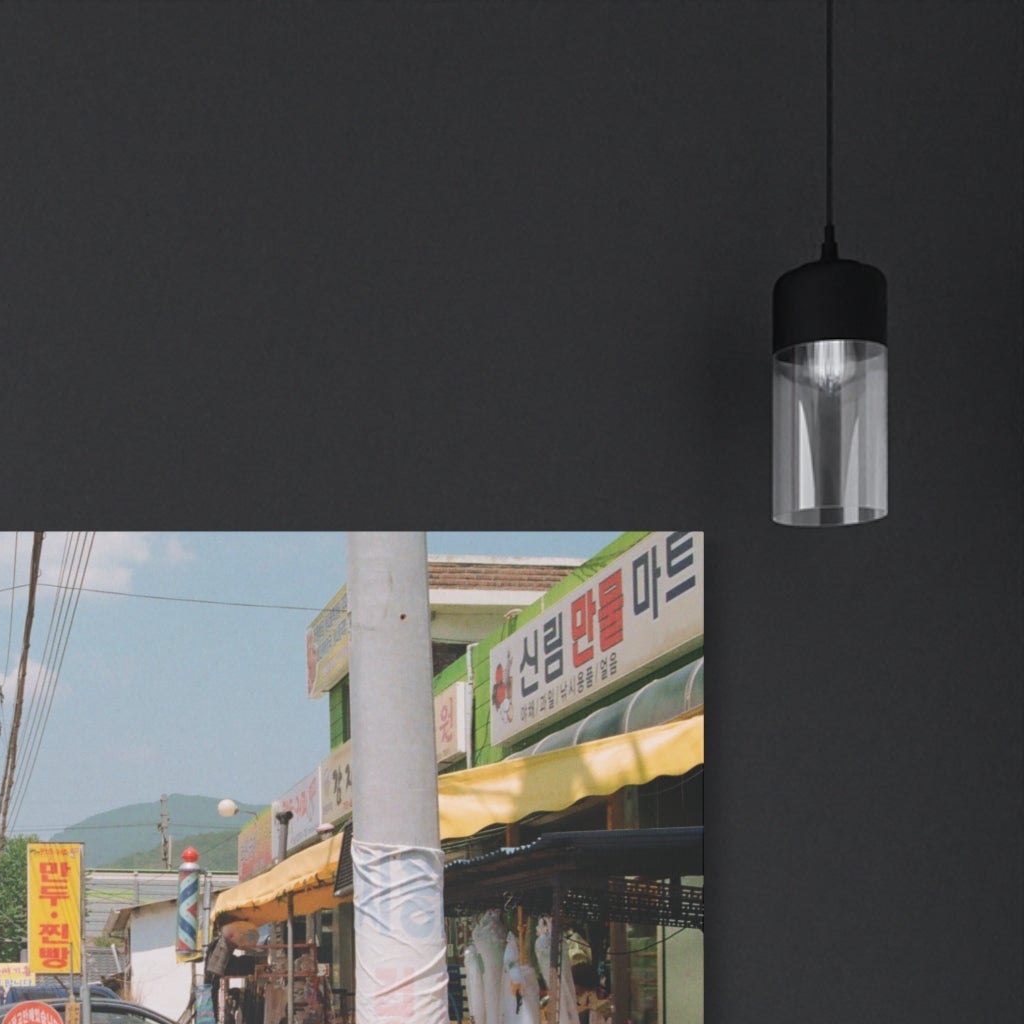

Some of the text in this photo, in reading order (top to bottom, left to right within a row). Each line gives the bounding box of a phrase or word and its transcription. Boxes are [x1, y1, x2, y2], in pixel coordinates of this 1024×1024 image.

[519, 531, 696, 698] 신림 만물 마트
